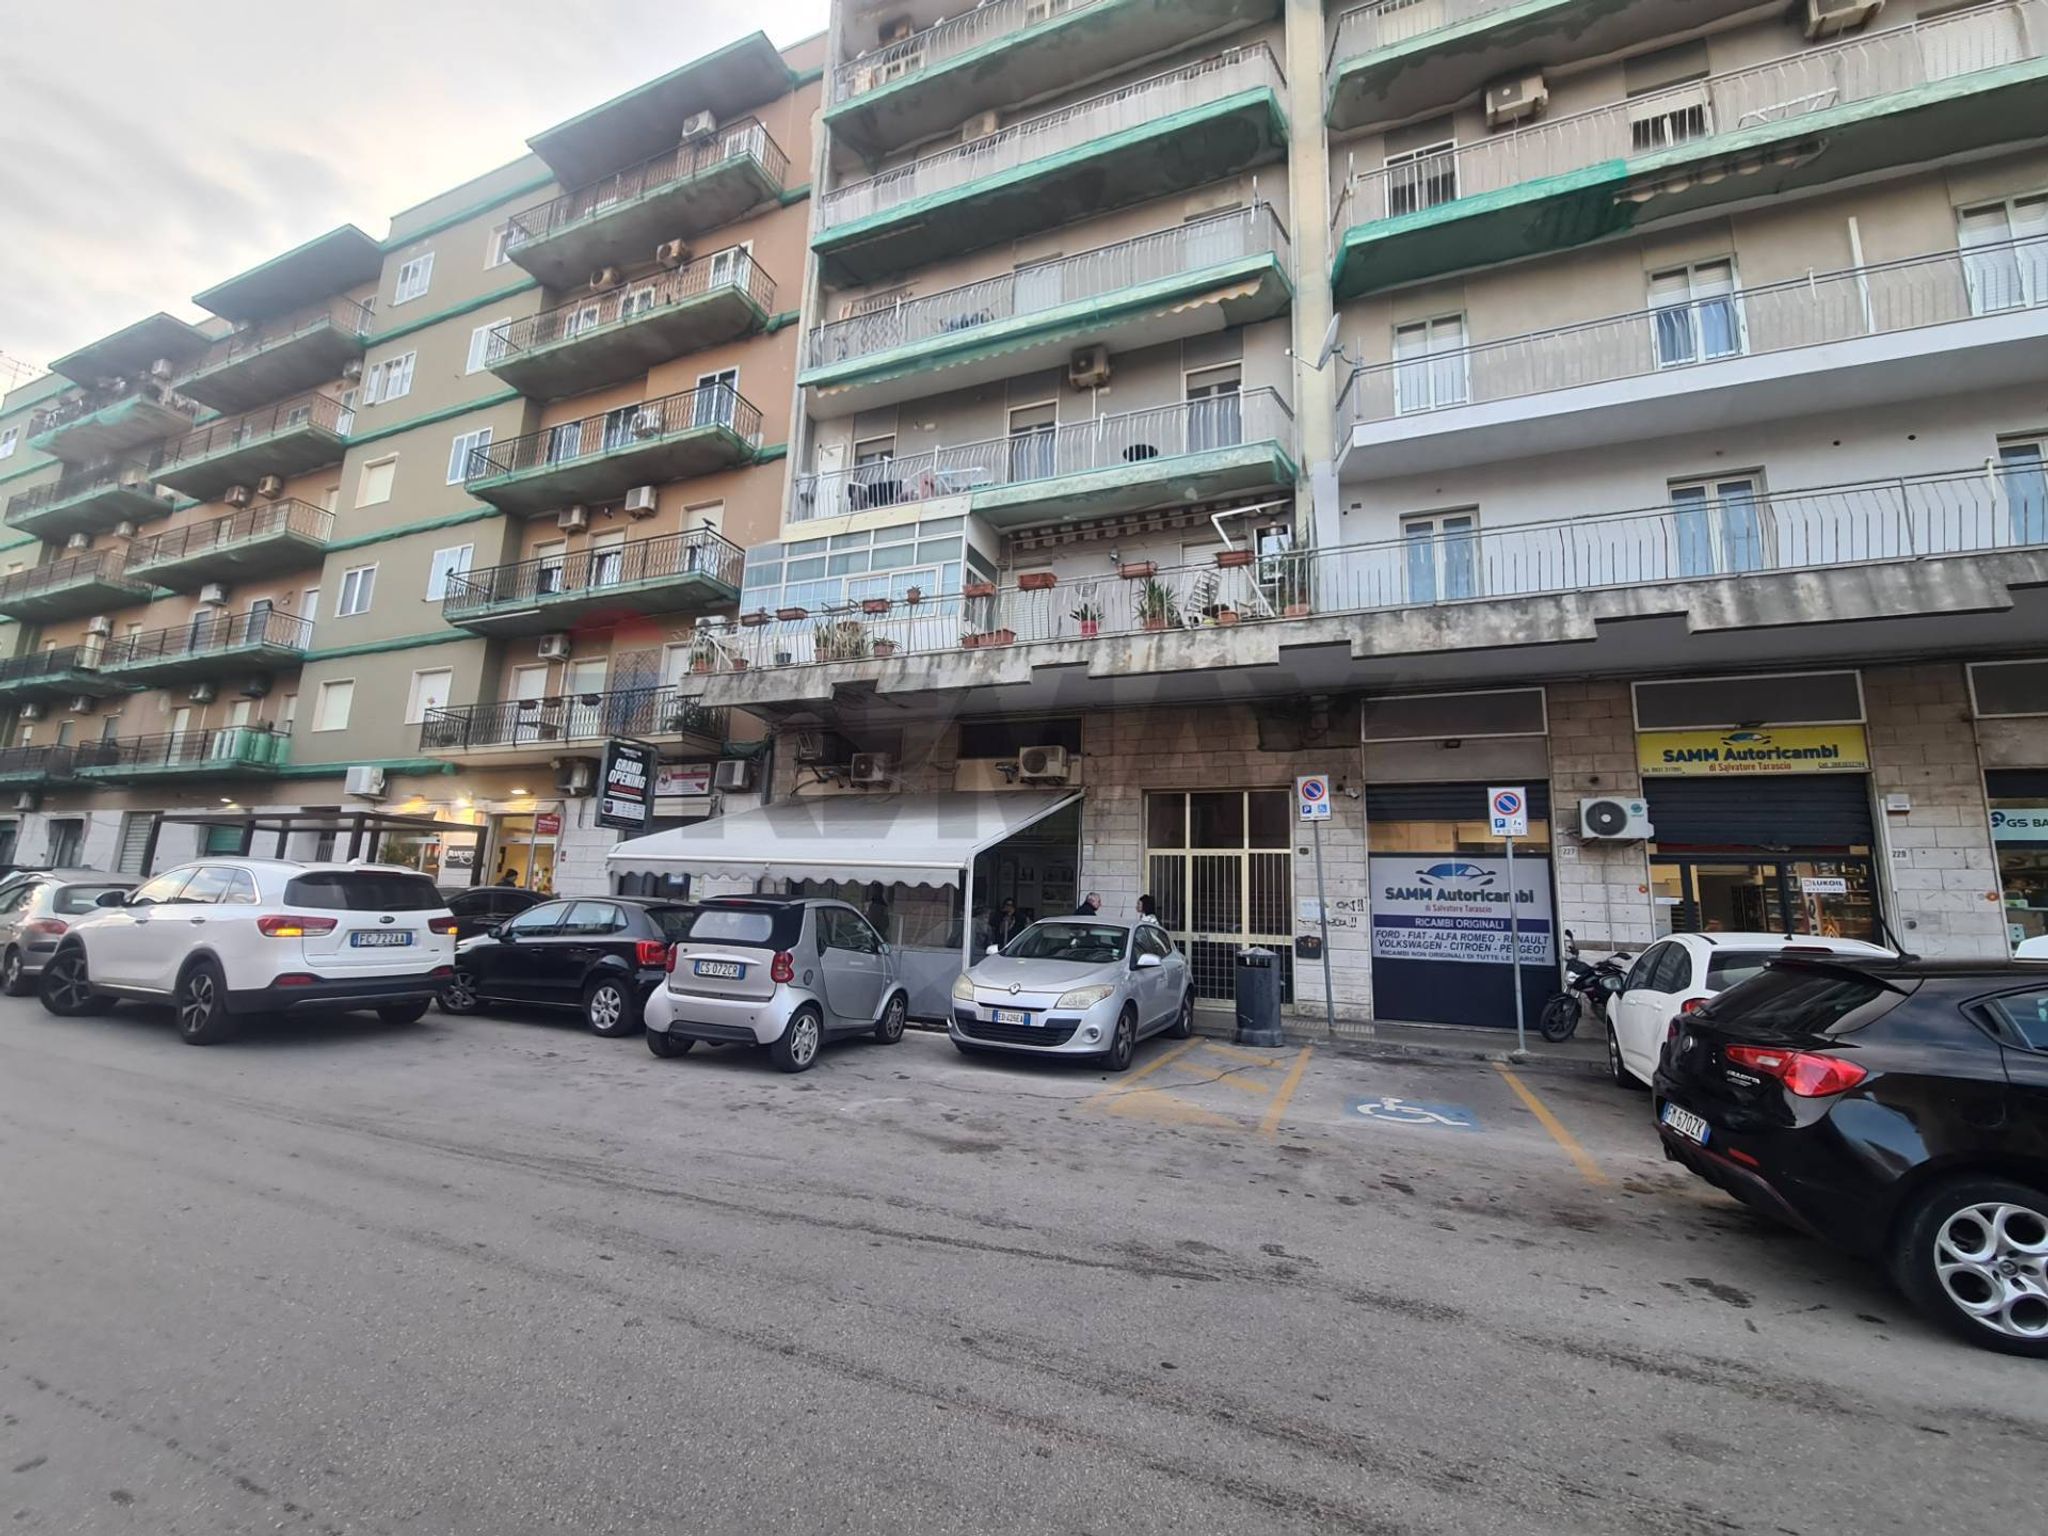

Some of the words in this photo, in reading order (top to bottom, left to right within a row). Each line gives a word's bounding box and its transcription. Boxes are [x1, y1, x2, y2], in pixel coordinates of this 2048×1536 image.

[1662, 747, 1719, 763] SAMM
[1723, 744, 1839, 761] Autoricambi
[614, 758, 644, 775] GRAND
[1708, 763, 1717, 772] di
[1718, 762, 1756, 772] Salvatore
[1758, 761, 1792, 771] Tarascio
[608, 769, 647, 789] OPENING
[2006, 818, 2028, 828] GS
[1562, 847, 1576, 856] 227
[1812, 878, 1843, 887] LUKOIL
[1385, 887, 1432, 901] SAMM
[1415, 918, 1454, 928] RICAMBI
[1456, 919, 1505, 929] ORIGINALI
[1375, 930, 1400, 939] FORD
[1408, 931, 1427, 940] FIAT
[1434, 932, 1458, 941] ALFA
[1460, 933, 1496, 943] ROMEO
[1503, 935, 1549, 945] RNAULT
[1378, 939, 1442, 950] VOLKSWAGEN
[1450, 942, 1492, 952] CITROEN
[1499, 944, 1547, 954] PEGEOT
